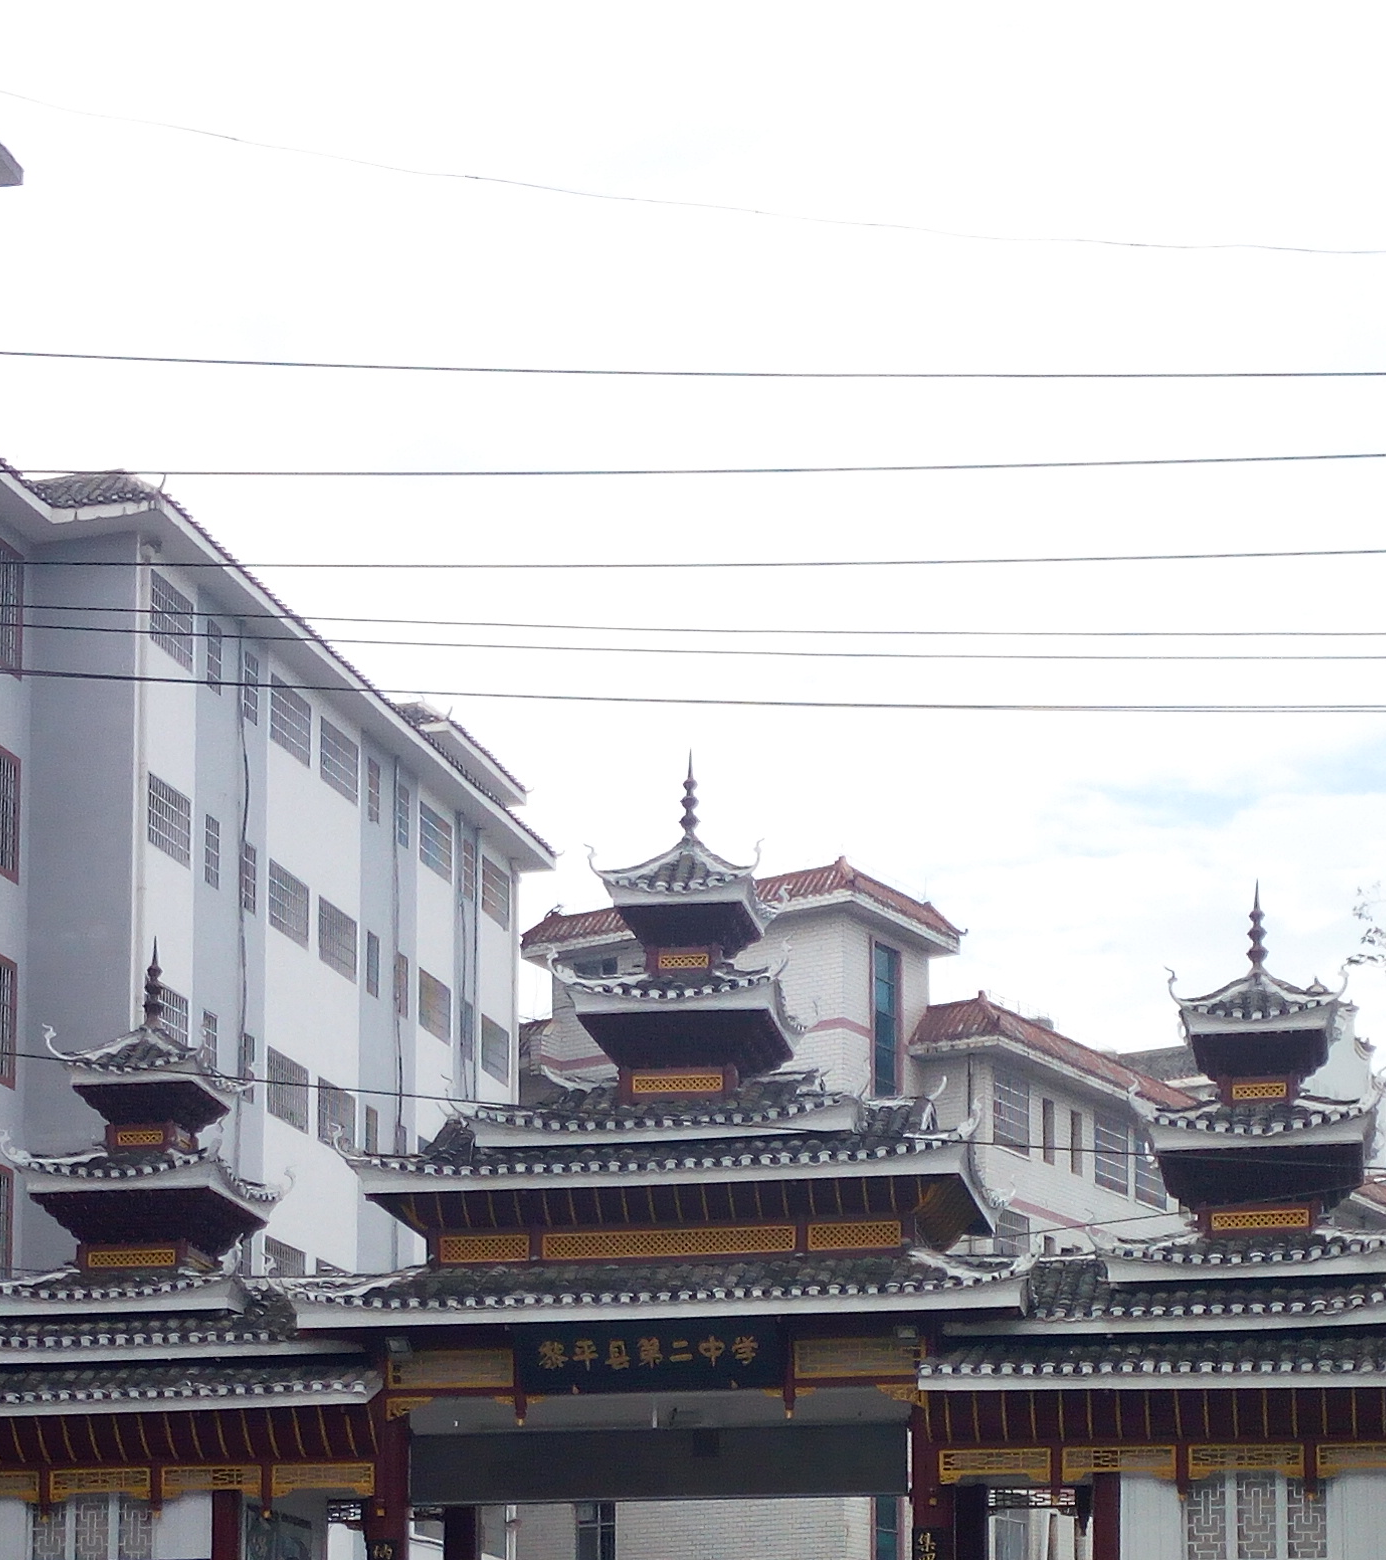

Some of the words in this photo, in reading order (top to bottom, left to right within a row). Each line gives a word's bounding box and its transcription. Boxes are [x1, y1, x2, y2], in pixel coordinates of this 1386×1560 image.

[537, 1335, 760, 1371] 黎平县第二中学
